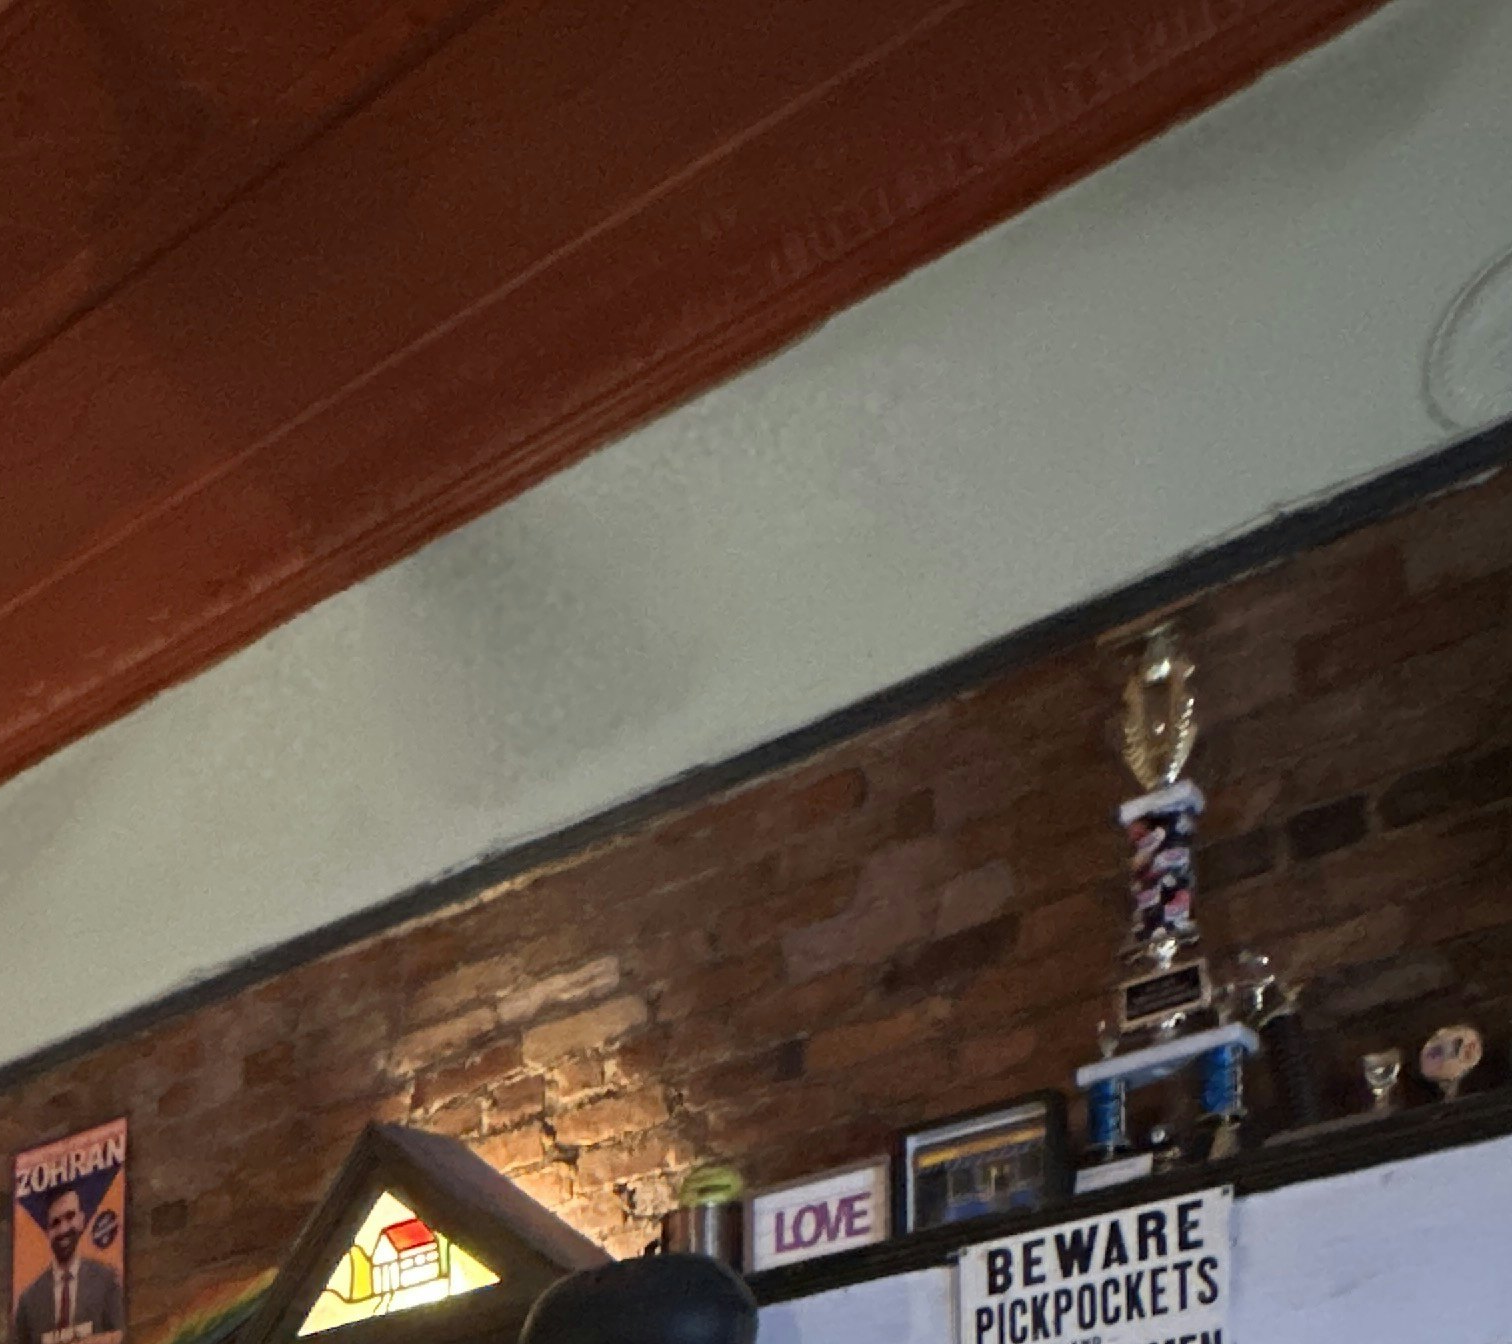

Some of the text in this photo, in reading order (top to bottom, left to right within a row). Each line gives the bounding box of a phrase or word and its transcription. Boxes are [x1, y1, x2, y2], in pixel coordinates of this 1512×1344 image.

[15, 1134, 126, 1199] ZOHRAN
[774, 1190, 872, 1254] LOVE
[987, 1199, 1204, 1296] BEWARE
